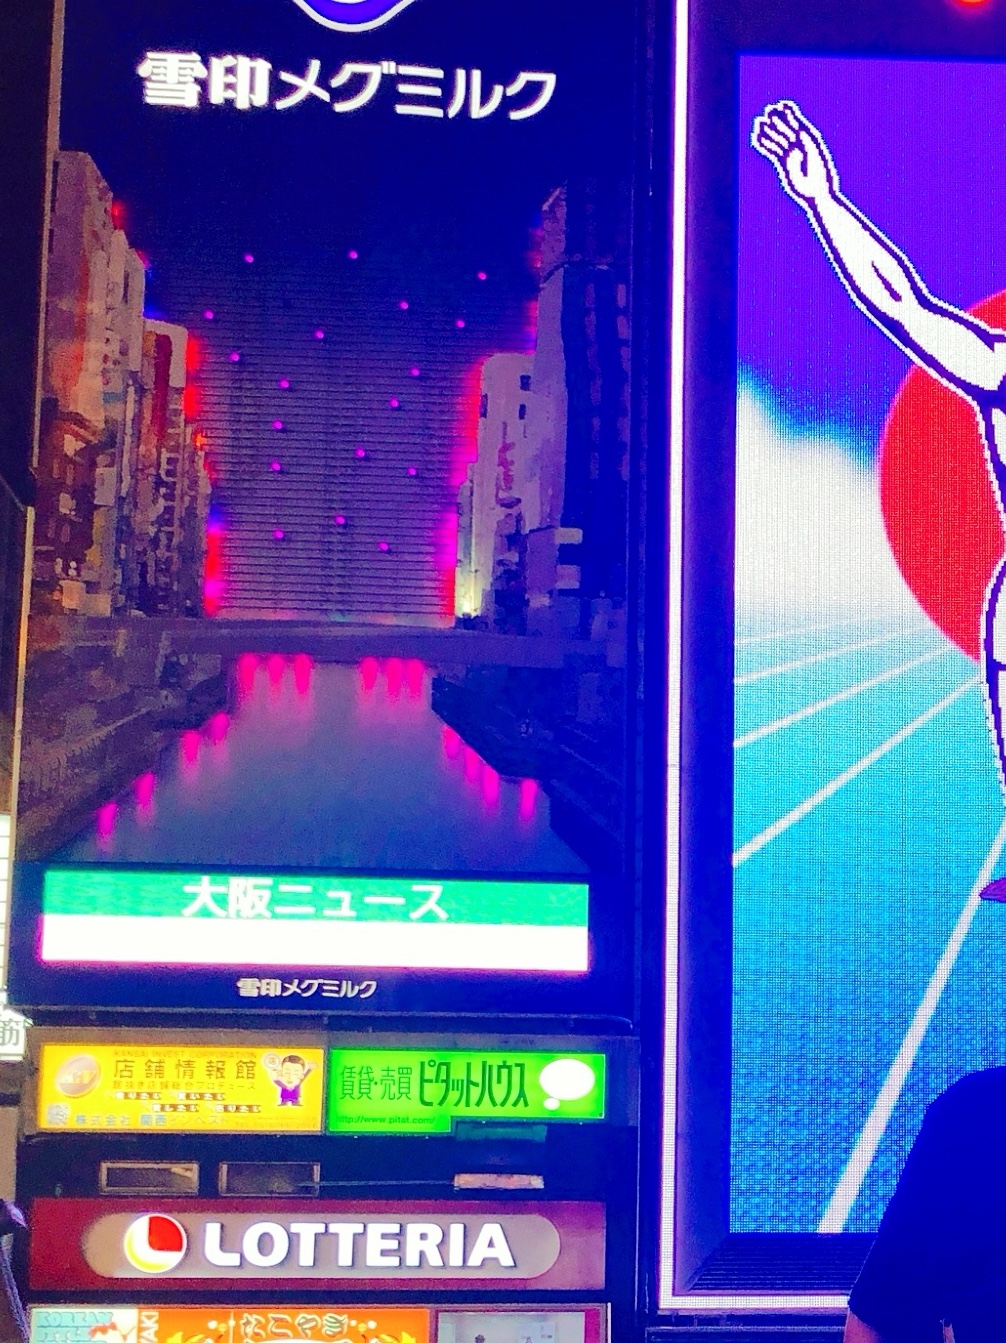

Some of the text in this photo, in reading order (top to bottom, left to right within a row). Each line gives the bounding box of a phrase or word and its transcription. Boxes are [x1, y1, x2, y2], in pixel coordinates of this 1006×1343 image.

[136, 50, 558, 121] 雪印メグミルク
[180, 874, 450, 921] 大阪ニュース
[236, 976, 378, 999] 雪印メグミルク
[113, 1058, 257, 1080] 店舗情報館
[204, 1221, 516, 1269] LOTTERIA
[240, 1312, 349, 1339] たこやき
